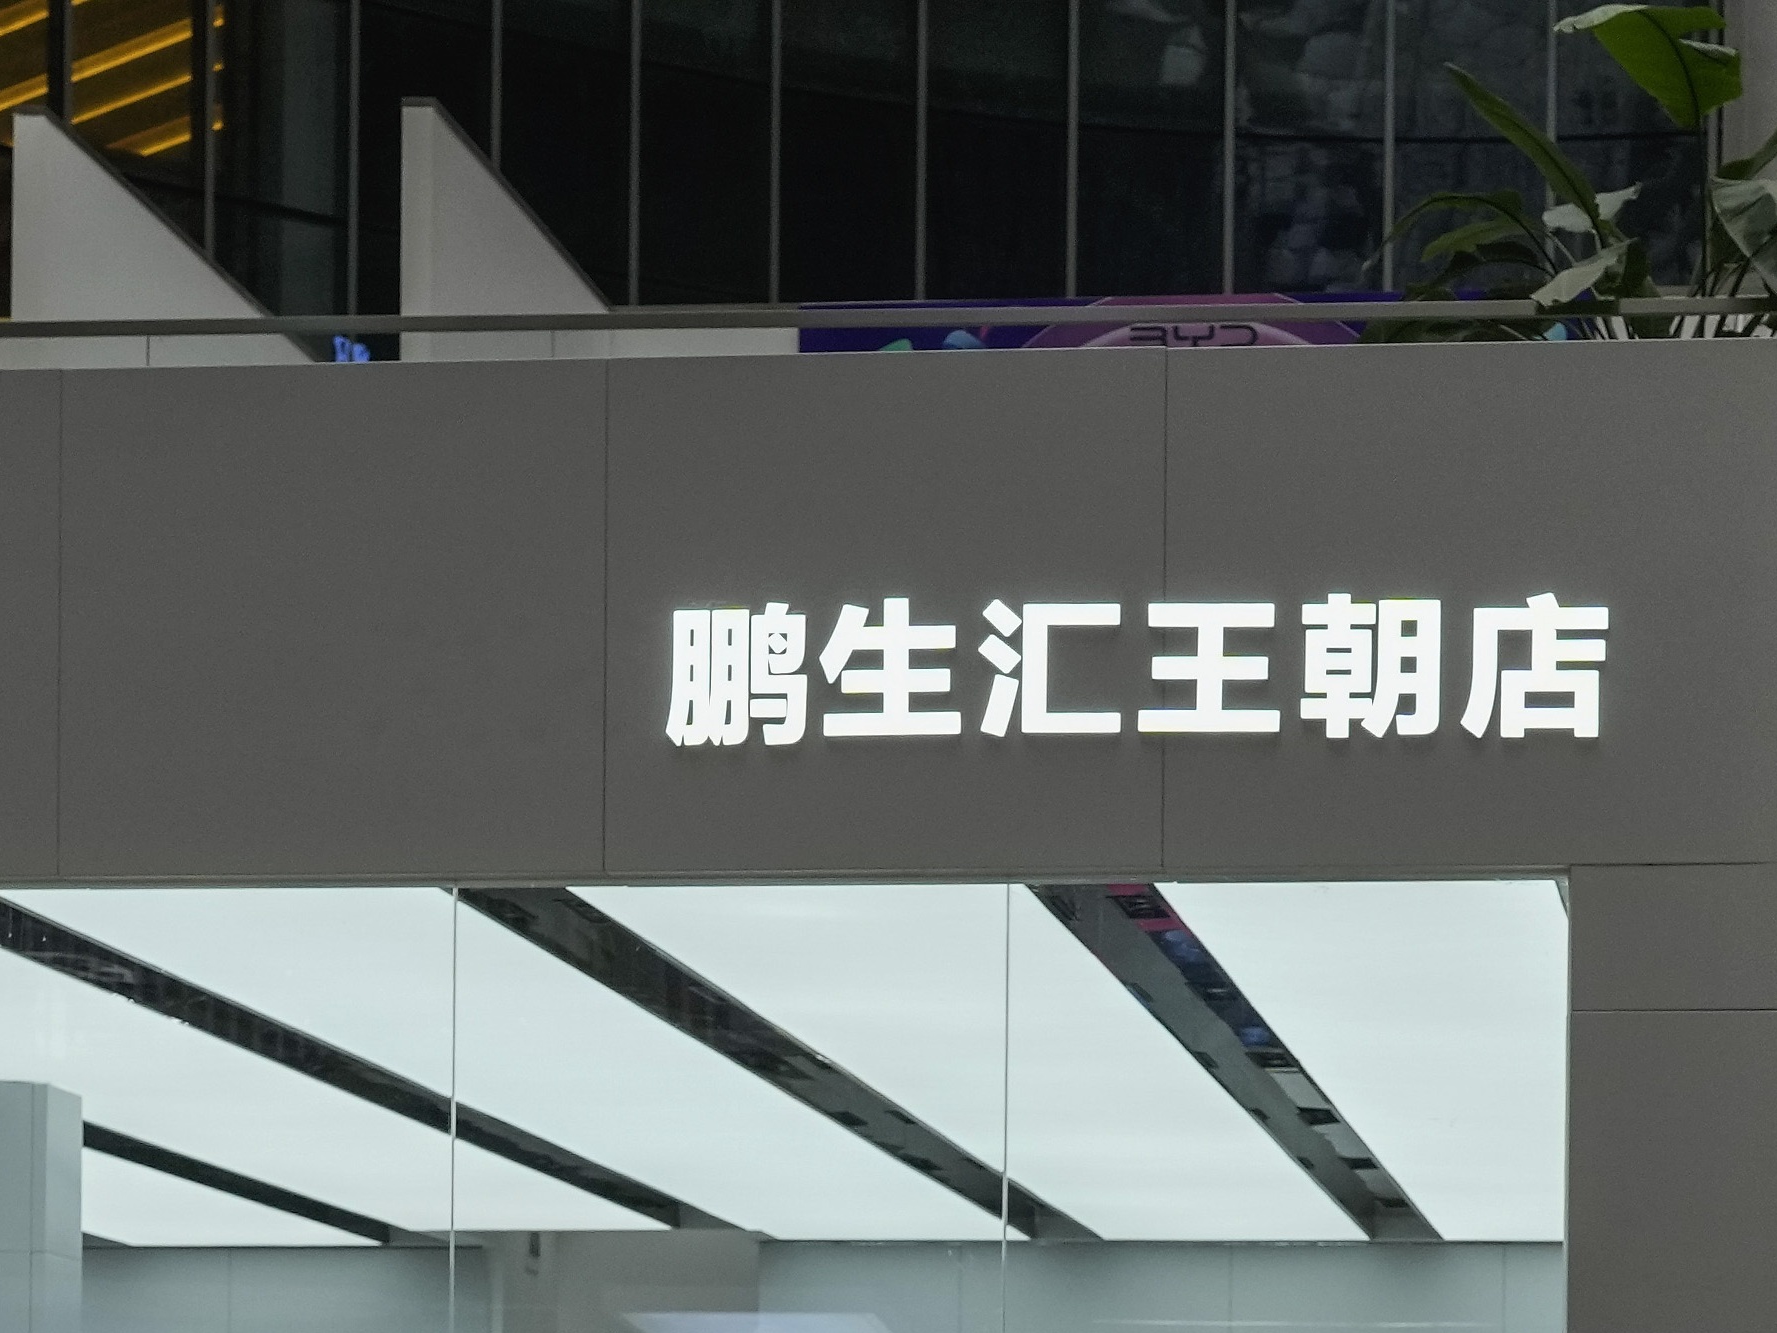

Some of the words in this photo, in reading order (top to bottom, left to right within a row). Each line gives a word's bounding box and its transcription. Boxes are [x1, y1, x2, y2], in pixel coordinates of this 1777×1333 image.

[1129, 324, 1259, 346] BYD
[664, 594, 1610, 748] 鹏生汇王朝店
